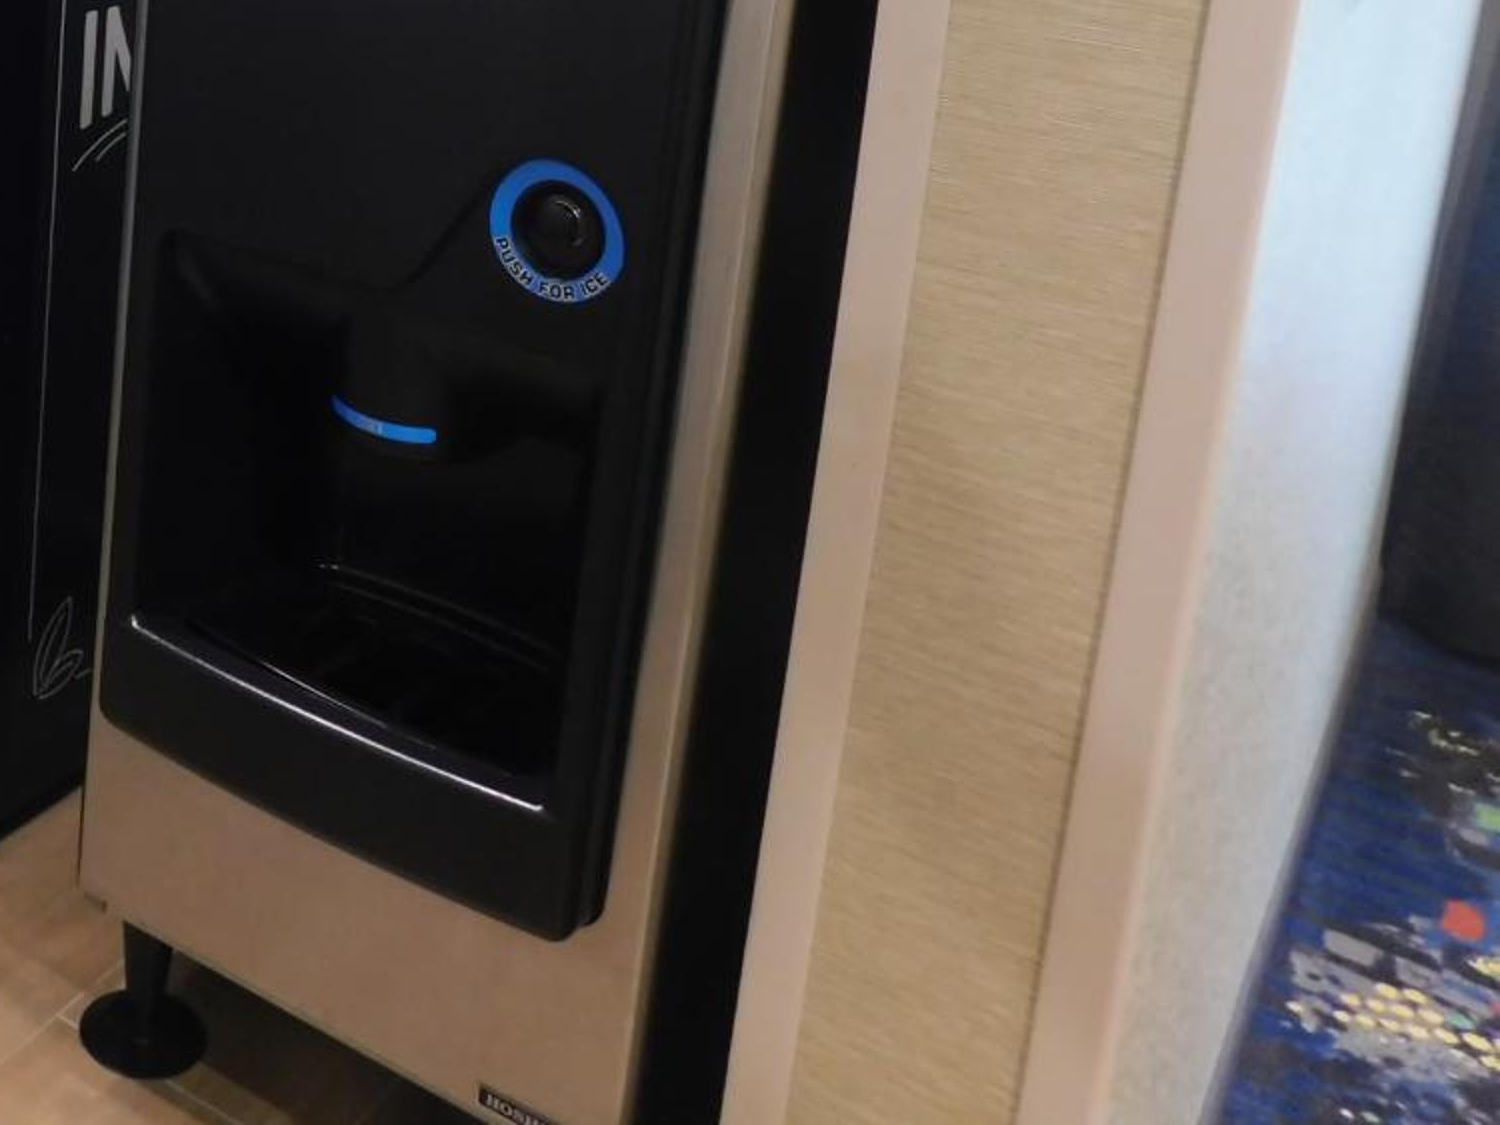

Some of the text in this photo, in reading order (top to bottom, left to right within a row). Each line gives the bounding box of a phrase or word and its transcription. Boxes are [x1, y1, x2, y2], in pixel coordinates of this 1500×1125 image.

[496, 236, 608, 301] PUSH FOR ICE
